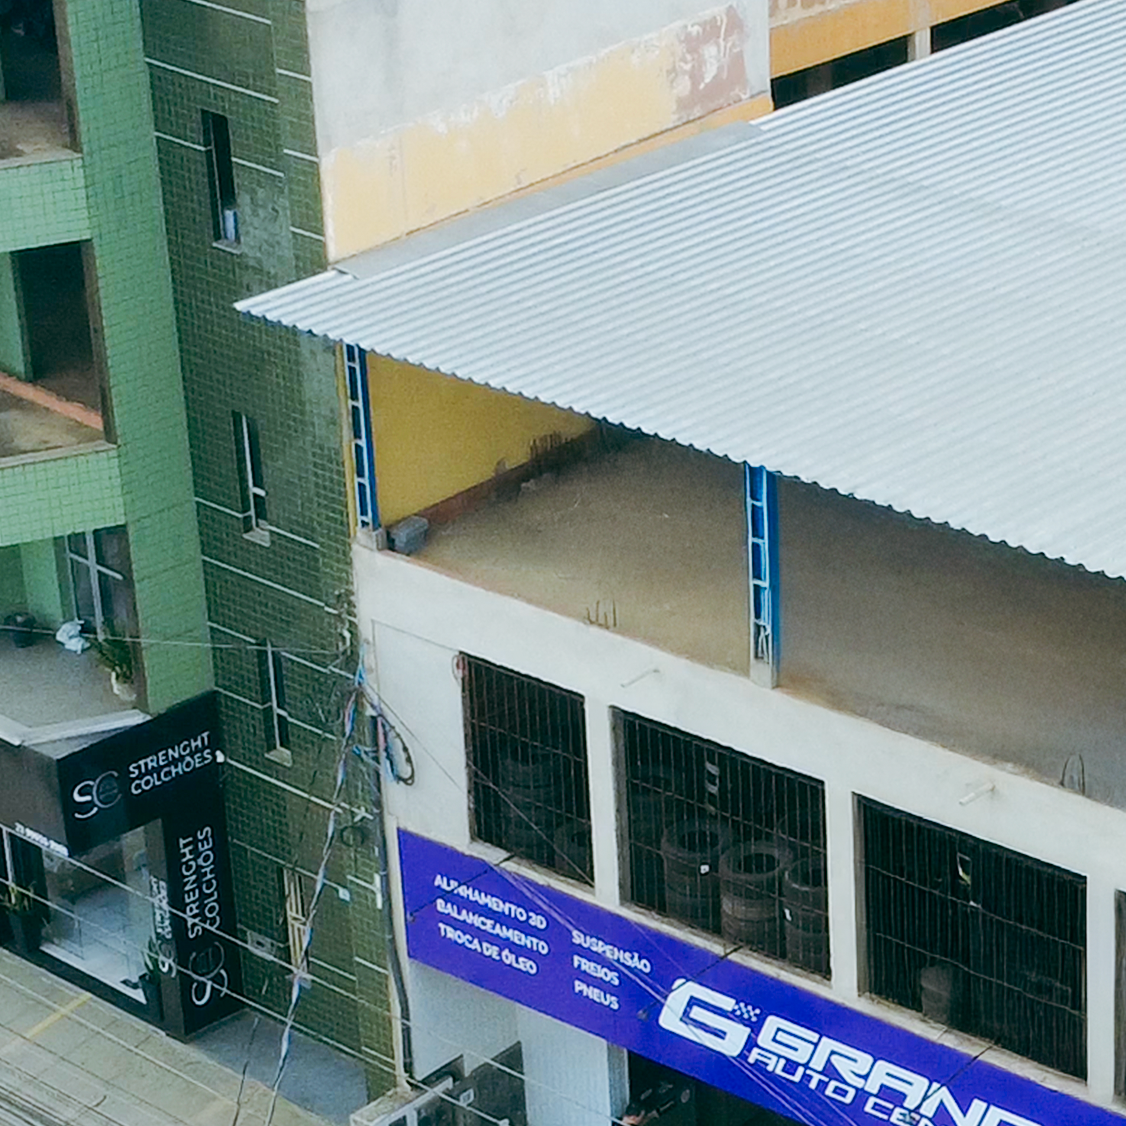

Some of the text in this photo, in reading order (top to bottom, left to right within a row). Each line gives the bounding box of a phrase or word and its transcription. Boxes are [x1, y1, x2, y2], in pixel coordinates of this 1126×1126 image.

[129, 731, 210, 778] STRENGHT
[131, 749, 213, 795] COLCHÕES
[434, 874, 527, 921] ALINHAMENTO
[436, 898, 549, 955] BALANCEAMENTO
[438, 922, 538, 975] TROCA DE ÓLEO
[572, 930, 651, 973] SUSPENSÃO
[573, 955, 620, 986] FREIOS
[574, 980, 619, 1010] PNEUS
[748, 1047, 857, 1105] AUTO
